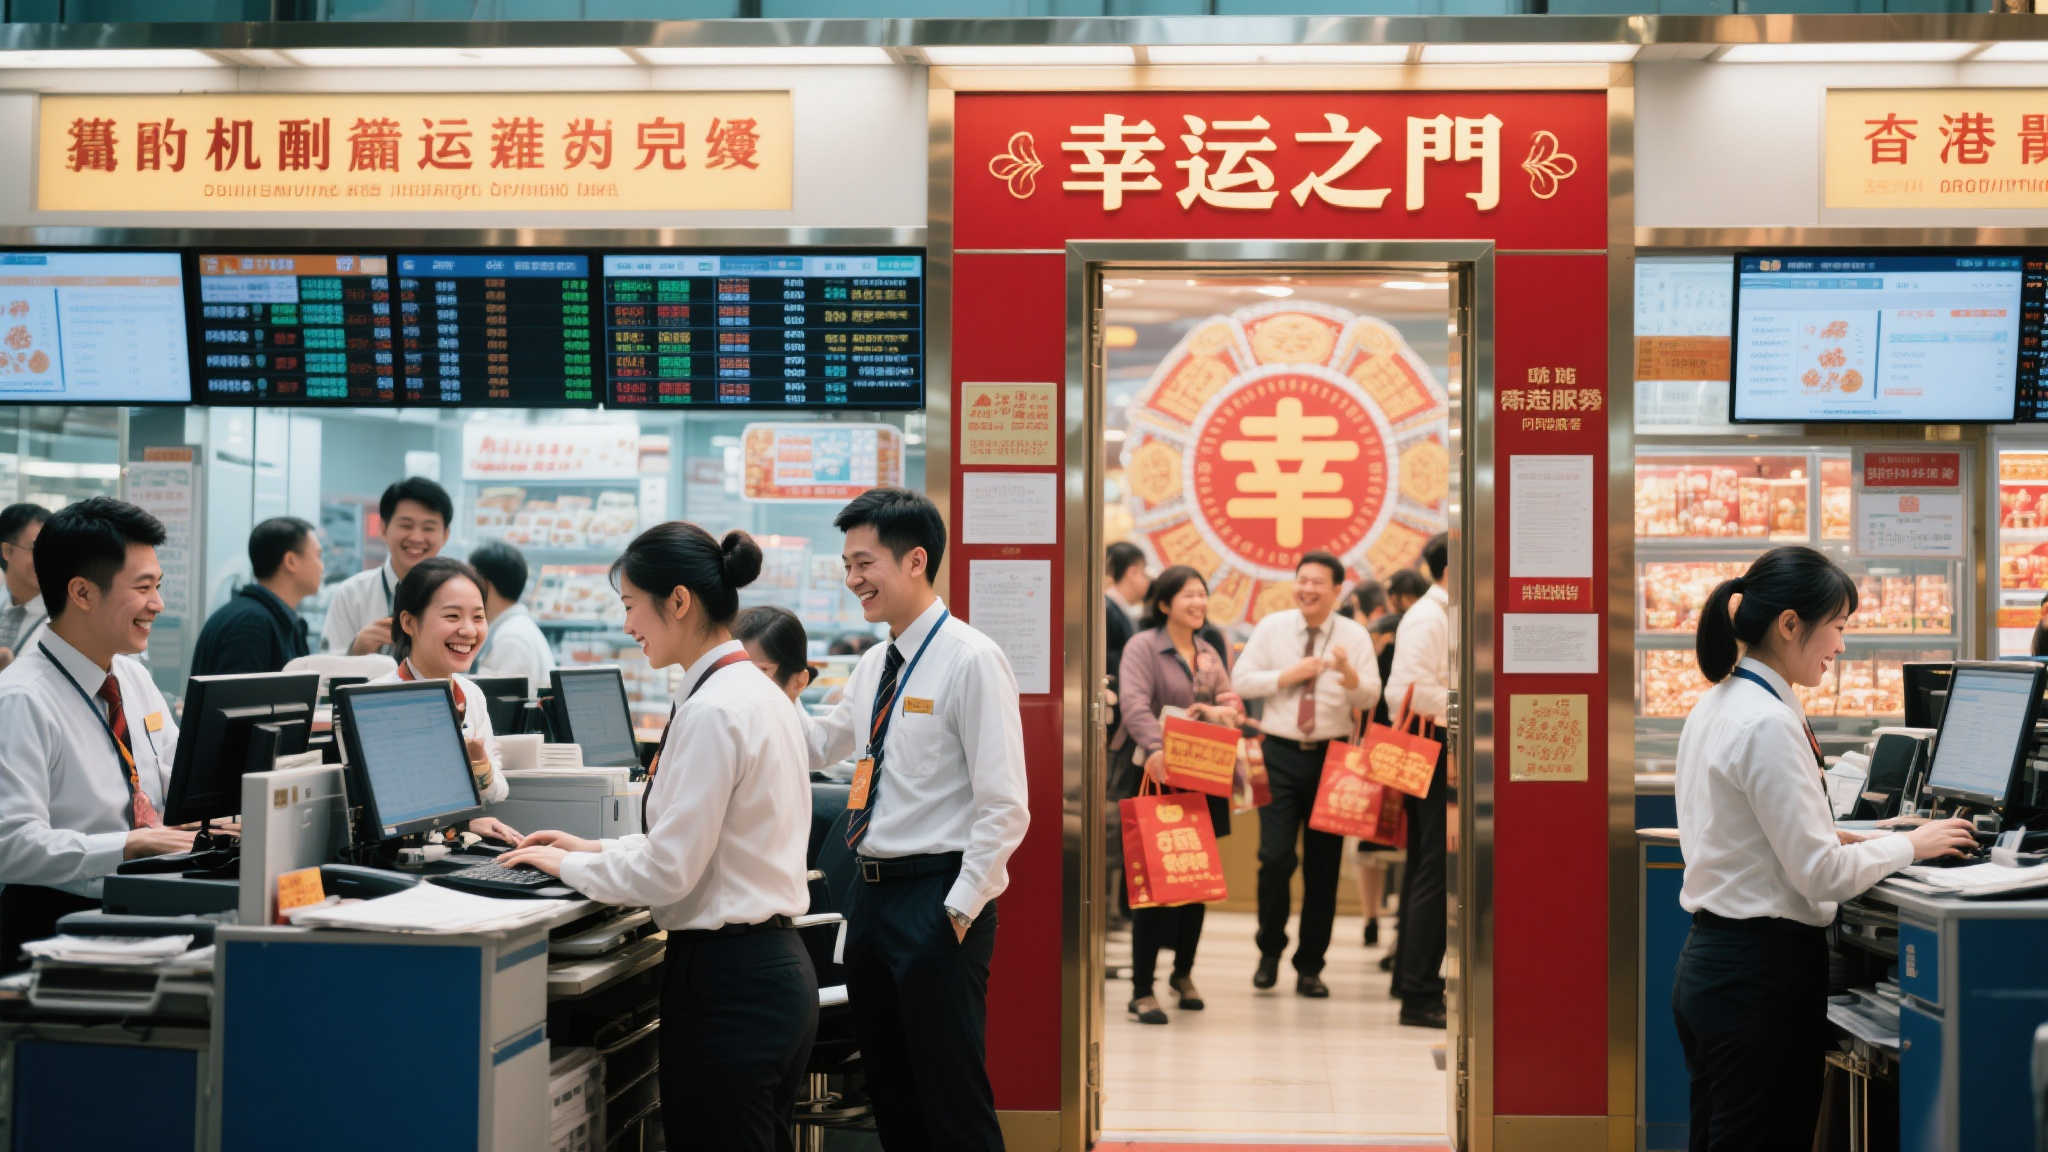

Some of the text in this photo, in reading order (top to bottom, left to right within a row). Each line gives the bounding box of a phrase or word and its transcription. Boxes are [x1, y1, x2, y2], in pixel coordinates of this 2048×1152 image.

[1061, 113, 1503, 211] 幸运之門
[1220, 397, 1359, 548] 幸
